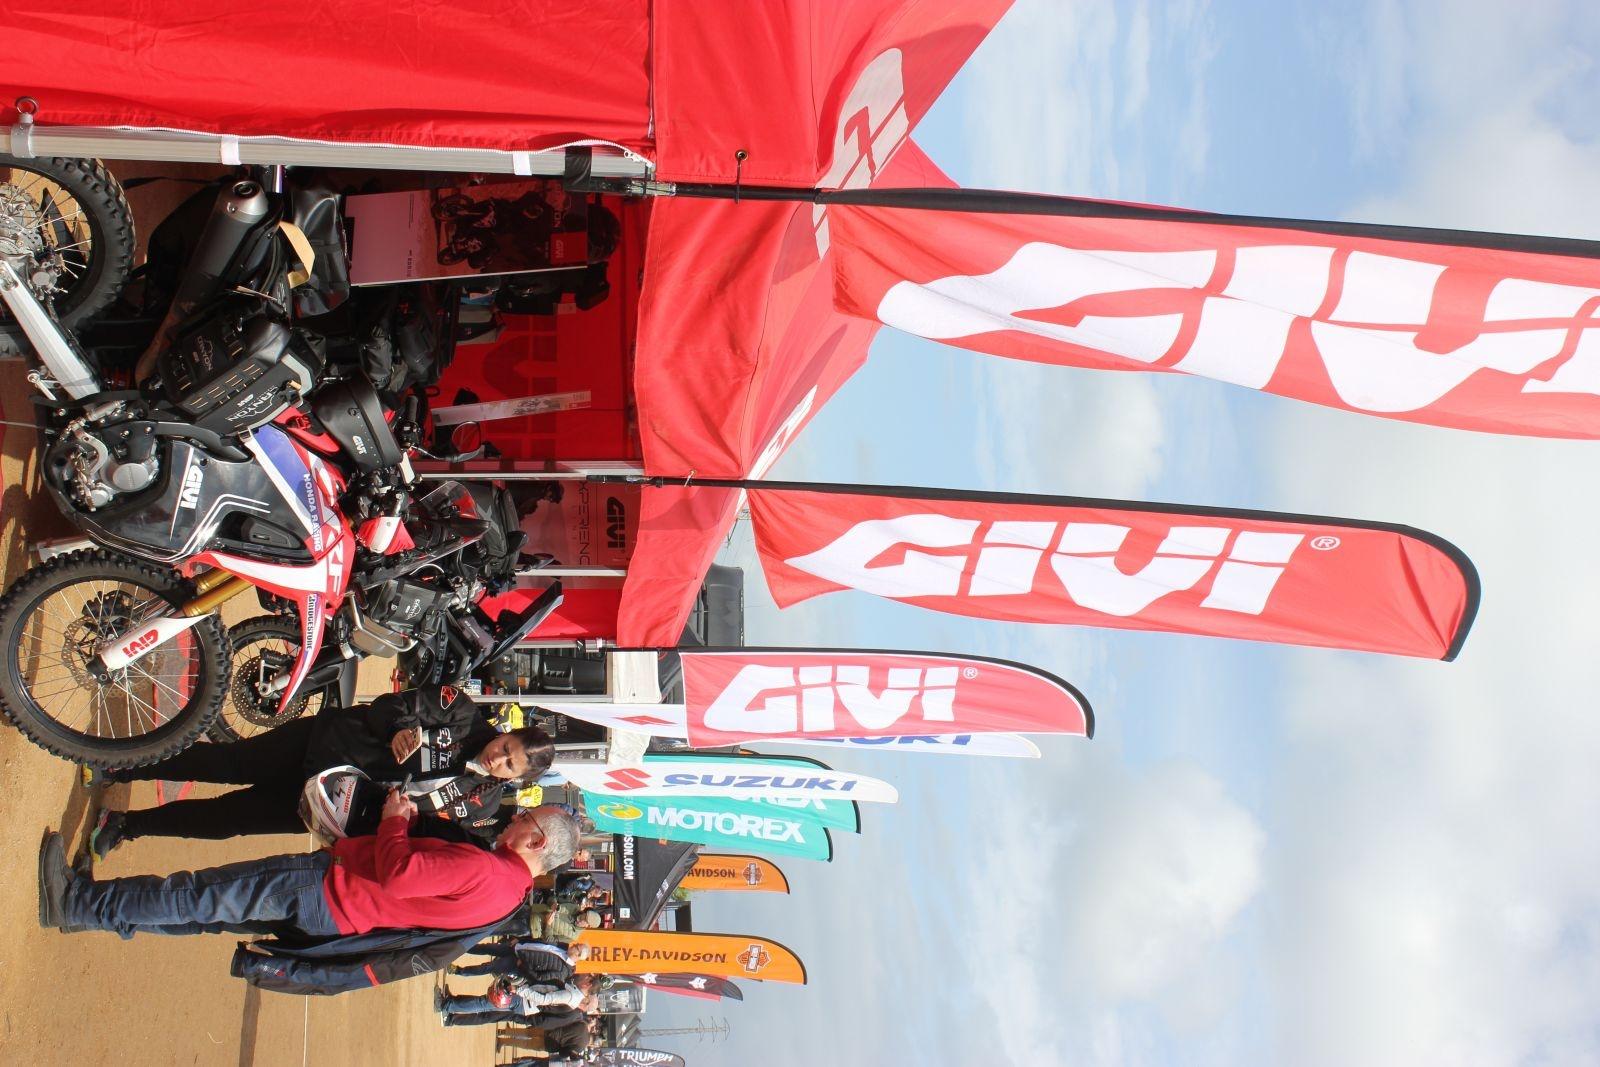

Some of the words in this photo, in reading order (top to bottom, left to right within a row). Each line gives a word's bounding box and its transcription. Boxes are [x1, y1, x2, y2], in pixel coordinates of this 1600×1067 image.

[180, 465, 203, 510] GIVI
[303, 473, 317, 512] HONDA
[311, 514, 323, 551] RACING
[578, 481, 590, 566] XPERIENC
[606, 497, 625, 549] GIVI
[784, 513, 1305, 616] GIVI
[122, 629, 158, 659] GIVI
[307, 596, 316, 650] BRIDGESTONE
[704, 664, 960, 733] GIVI
[662, 773, 857, 792] SUZUKI
[647, 806, 806, 844] MOTOREX
[585, 946, 728, 963] RLEY-DAVIDSON
[619, 1050, 674, 1062] TRIUMPH
